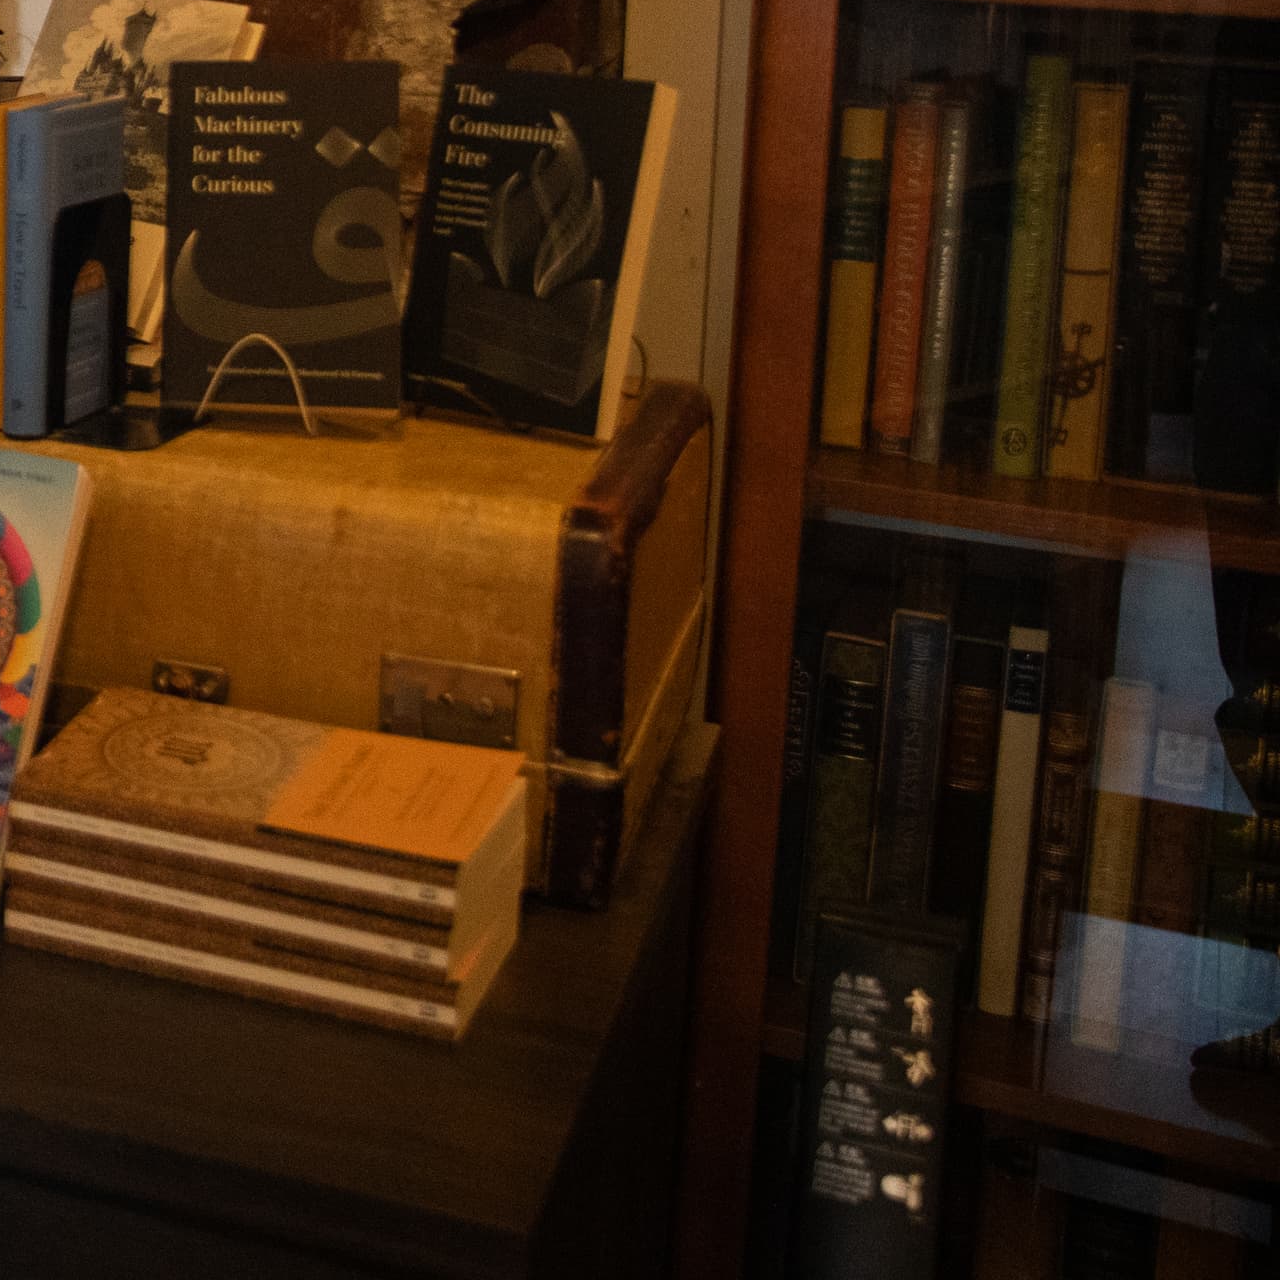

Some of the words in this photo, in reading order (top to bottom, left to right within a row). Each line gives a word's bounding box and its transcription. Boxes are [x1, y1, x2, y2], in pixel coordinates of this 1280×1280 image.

[193, 85, 288, 107] Fabulous
[454, 82, 497, 108] The
[193, 114, 304, 140] Machinery
[447, 113, 567, 150] Consuming
[191, 144, 224, 164] for
[227, 144, 264, 165] the
[444, 143, 500, 169] Fire
[191, 174, 276, 195] Curious
